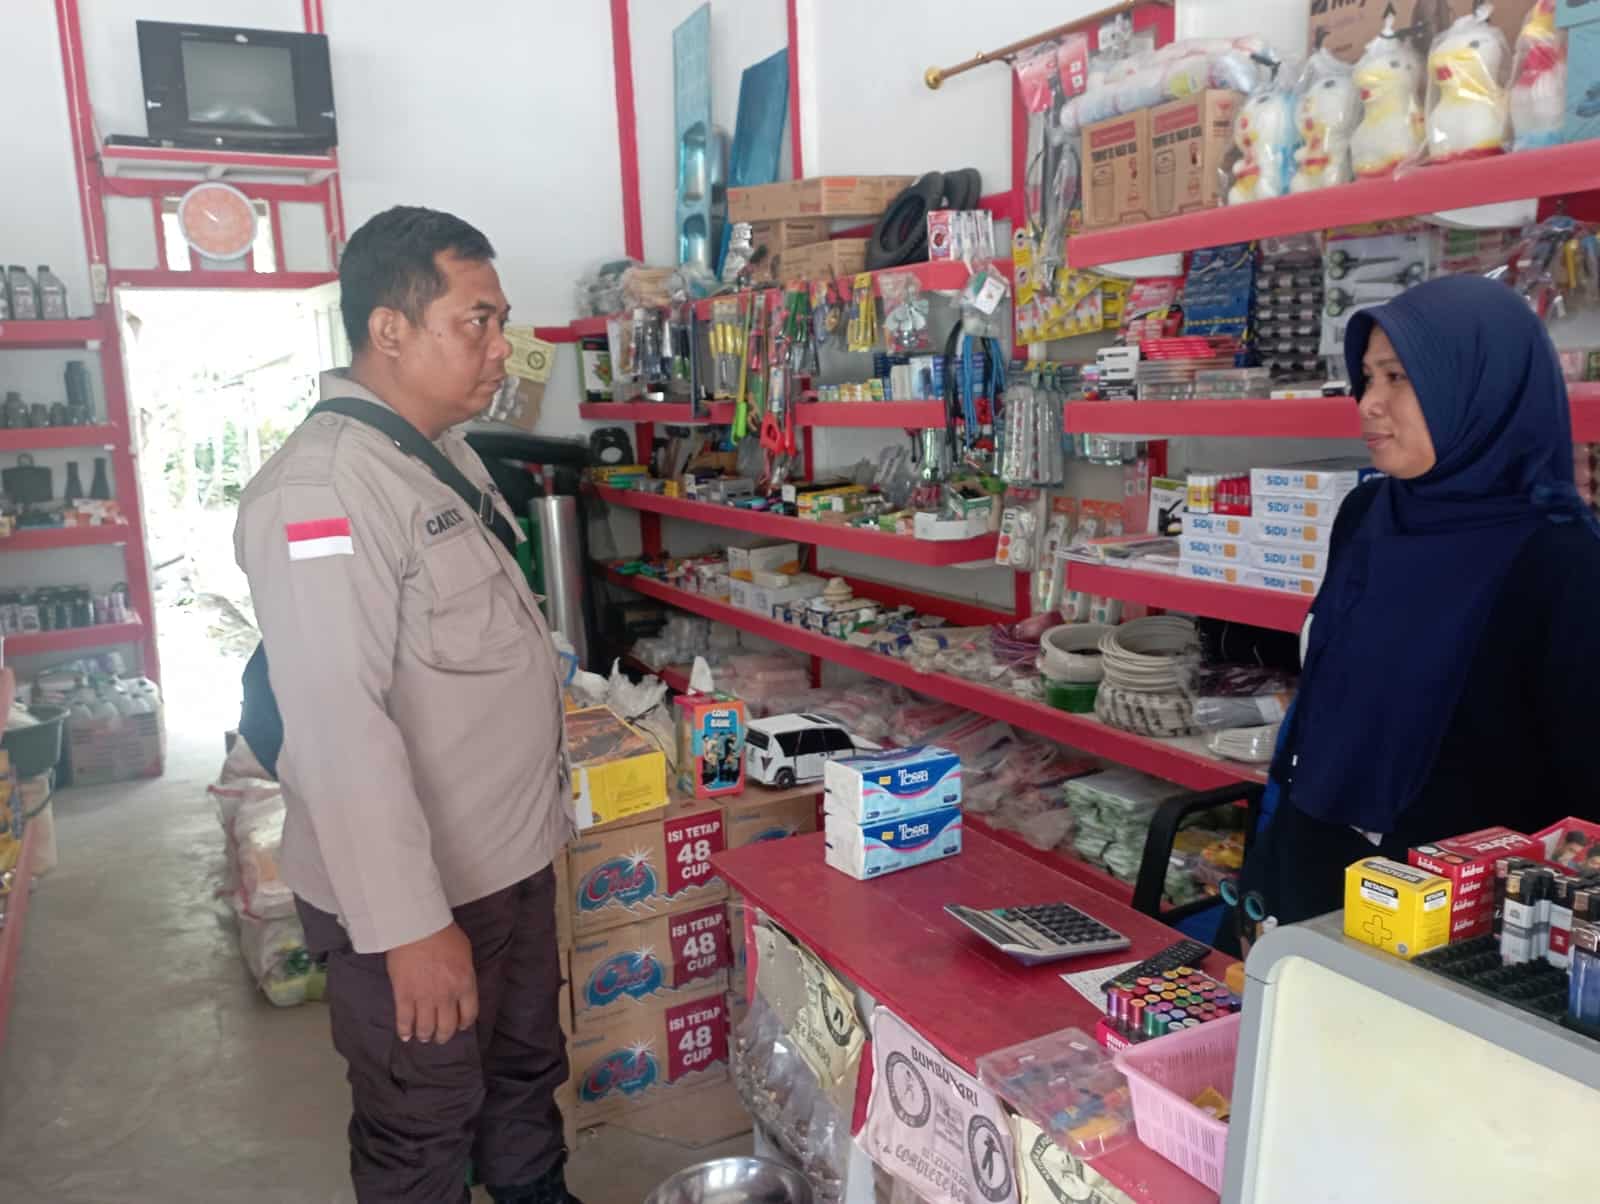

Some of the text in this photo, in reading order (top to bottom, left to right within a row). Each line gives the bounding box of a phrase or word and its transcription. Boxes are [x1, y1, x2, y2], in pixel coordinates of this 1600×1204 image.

[667, 821, 721, 843] ISI TETAP
[677, 839, 711, 864] 48
[681, 862, 711, 879] CUP
[672, 913, 723, 937] ISI TETAP
[683, 932, 717, 958] 48
[687, 954, 717, 971] CUP
[669, 1006, 721, 1032] ISI TETAP
[678, 1025, 713, 1051] 48
[682, 1047, 713, 1066] CUP
